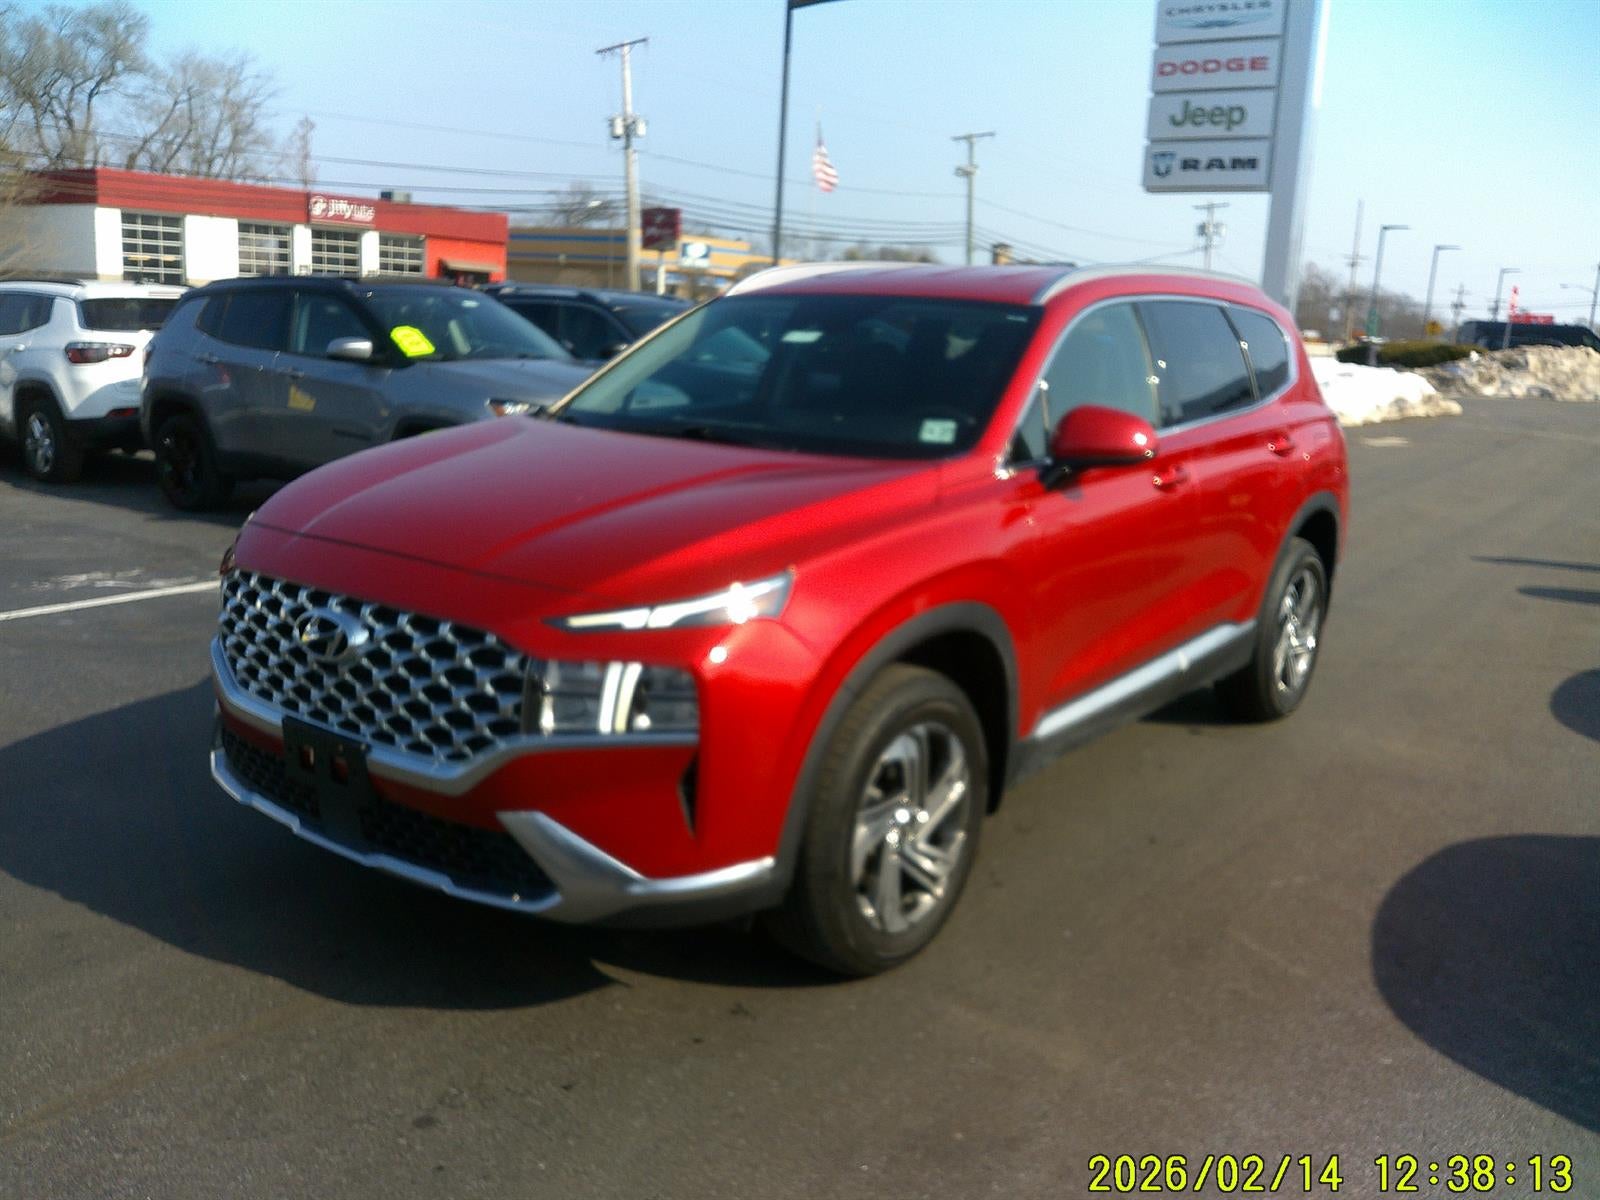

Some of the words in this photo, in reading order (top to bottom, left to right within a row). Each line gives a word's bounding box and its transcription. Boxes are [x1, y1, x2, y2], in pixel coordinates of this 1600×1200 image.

[1157, 56, 1269, 76] DODGE
[1169, 100, 1246, 131] Jeep
[1181, 158, 1258, 170] RAM
